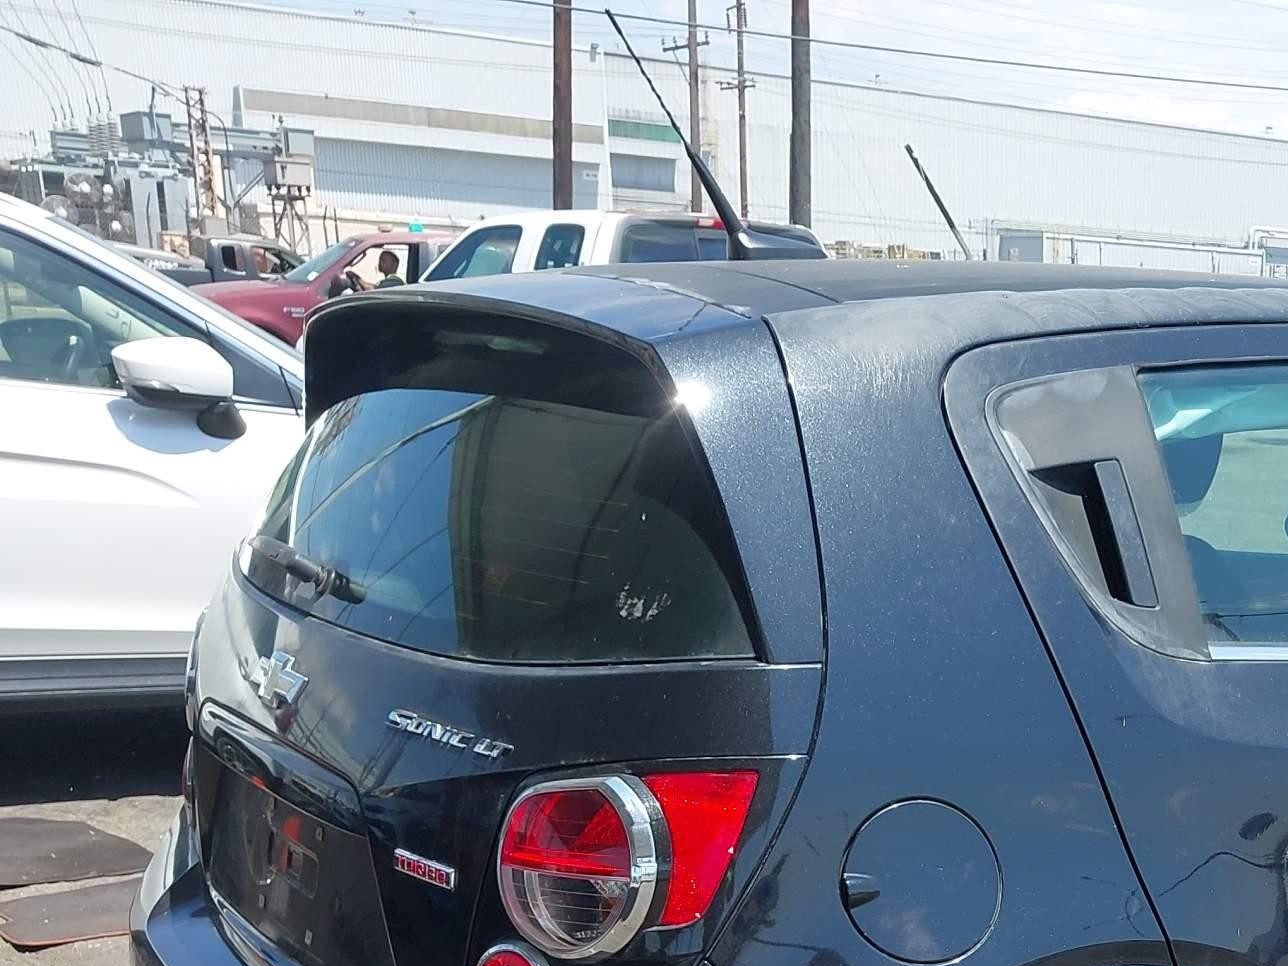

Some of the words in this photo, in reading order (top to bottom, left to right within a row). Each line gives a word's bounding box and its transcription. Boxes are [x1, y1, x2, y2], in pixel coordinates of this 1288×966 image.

[384, 707, 476, 748] SONIC
[472, 737, 515, 758] LT
[394, 852, 449, 886] TURBO
